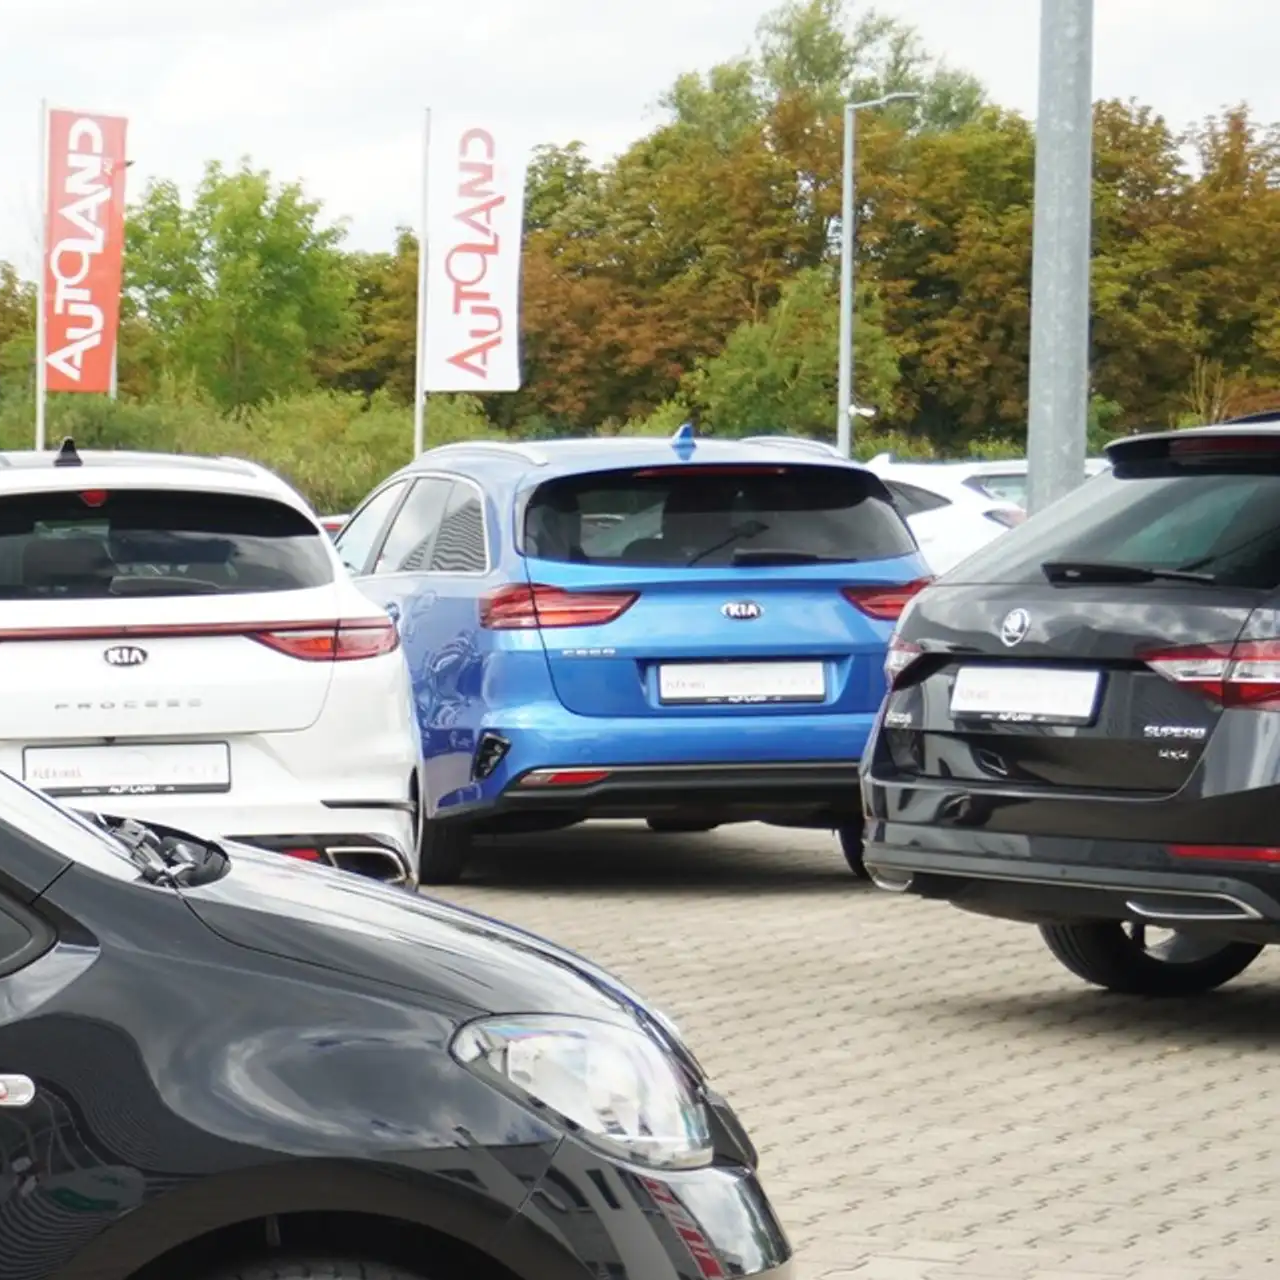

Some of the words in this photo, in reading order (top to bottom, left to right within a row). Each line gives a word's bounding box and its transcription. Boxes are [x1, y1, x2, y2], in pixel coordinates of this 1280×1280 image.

[45, 117, 112, 381] AUTOLAND
[445, 127, 507, 379] AUTOLAND
[729, 602, 758, 616] KIA
[107, 648, 144, 664] KIA
[1143, 726, 1207, 739] SUPERB
